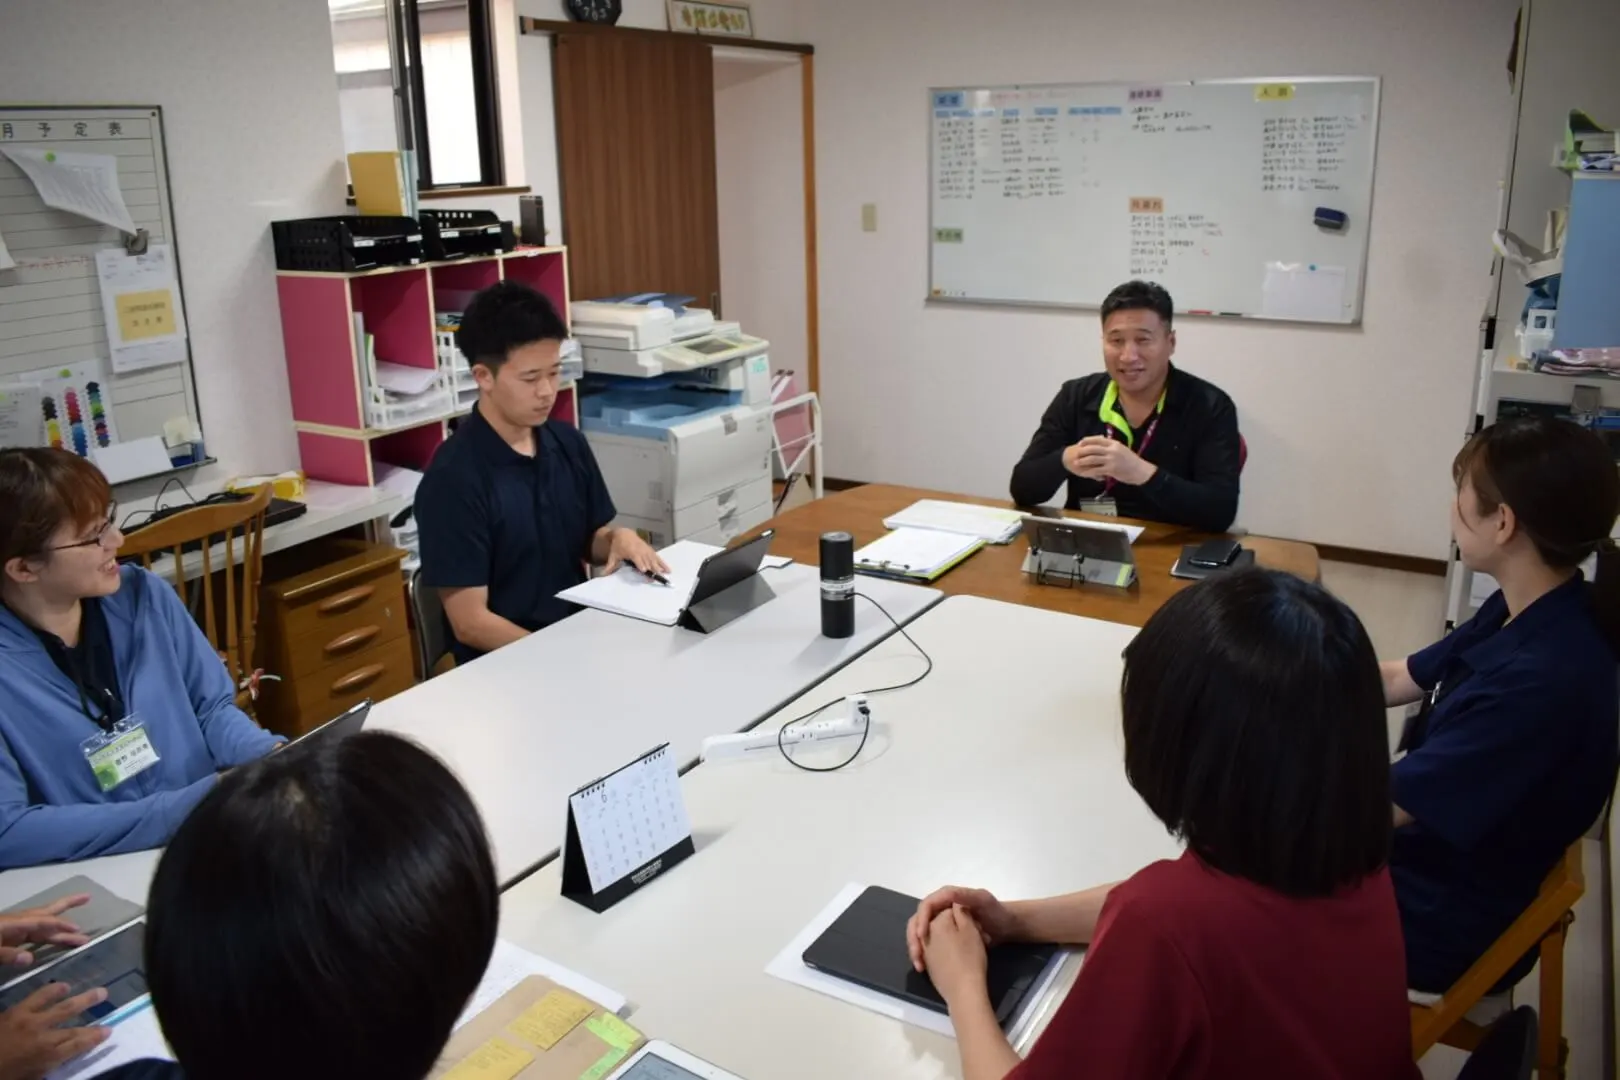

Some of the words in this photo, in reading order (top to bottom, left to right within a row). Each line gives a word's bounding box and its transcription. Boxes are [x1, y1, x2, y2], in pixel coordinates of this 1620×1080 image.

[583, 6, 590, 17] 7
[2, 121, 124, 139] 月予定表
[601, 788, 608, 803] 6
